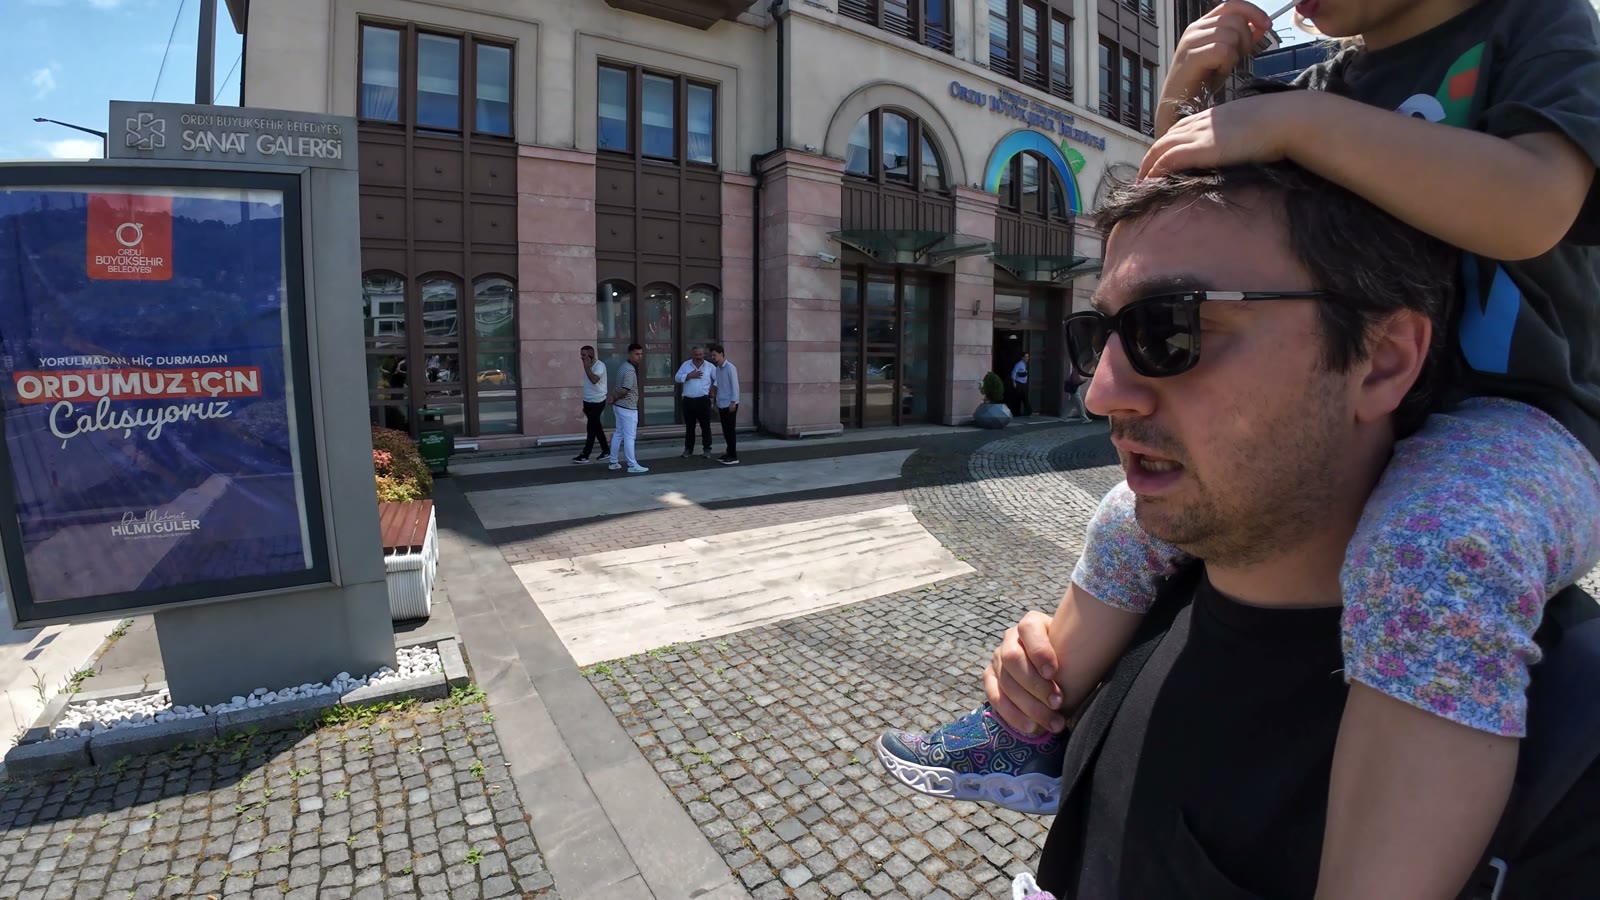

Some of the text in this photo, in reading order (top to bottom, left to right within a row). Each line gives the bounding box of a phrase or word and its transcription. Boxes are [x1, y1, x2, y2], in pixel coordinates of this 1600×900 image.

[180, 113, 214, 127] ORDU
[182, 129, 250, 154] SANAT
[117, 248, 142, 256] ORDU
[156, 354, 229, 366] DURMADAN
[16, 372, 187, 400] ORDUMUZ
